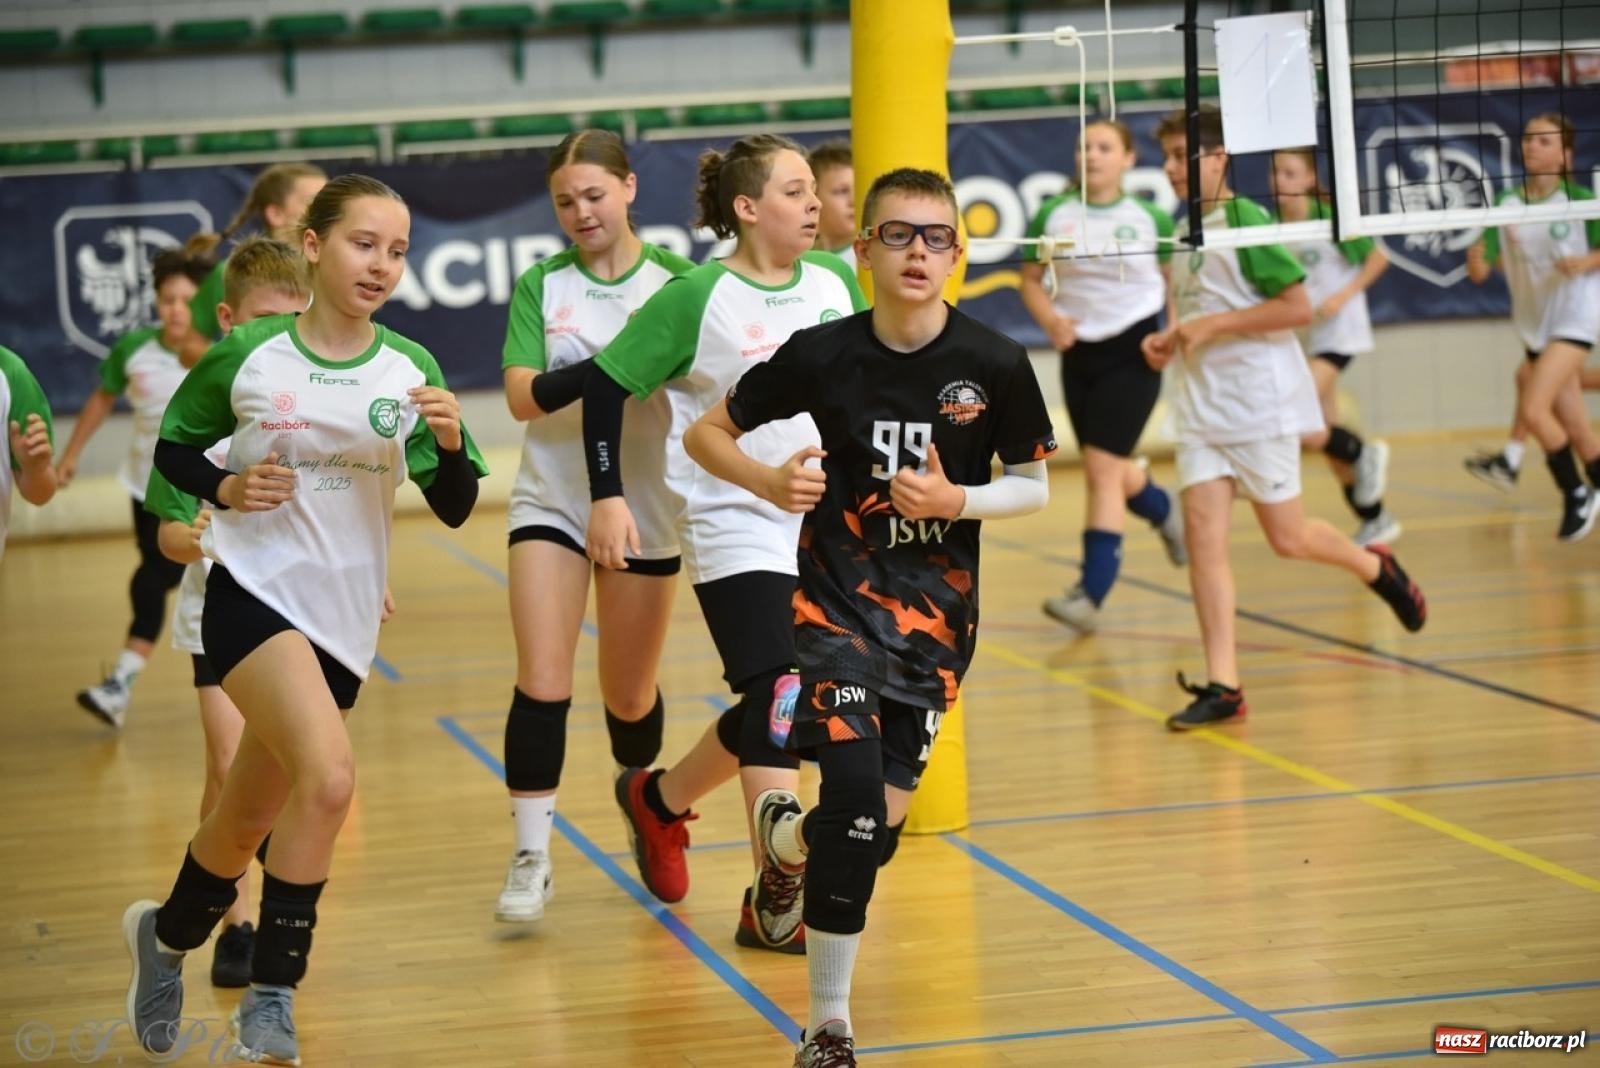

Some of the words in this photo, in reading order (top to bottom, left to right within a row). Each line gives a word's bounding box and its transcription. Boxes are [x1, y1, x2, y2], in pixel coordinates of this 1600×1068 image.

[871, 420, 932, 481] 99
[324, 454, 348, 469] dla
[313, 476, 352, 492] 2025
[887, 516, 952, 549] JSW
[834, 686, 866, 707] JSW
